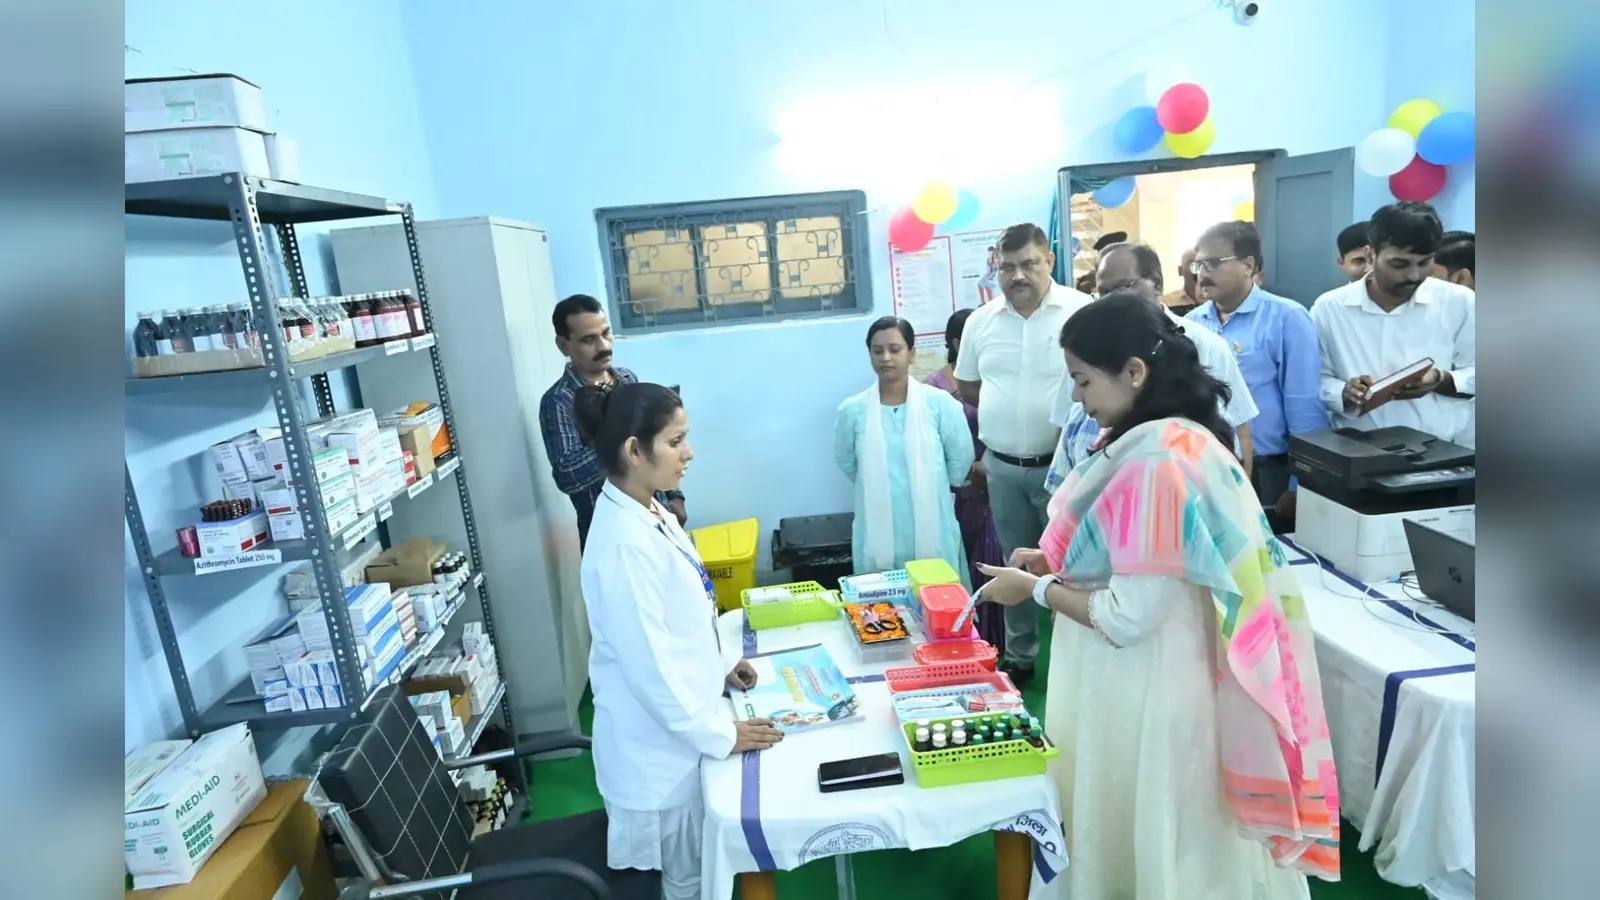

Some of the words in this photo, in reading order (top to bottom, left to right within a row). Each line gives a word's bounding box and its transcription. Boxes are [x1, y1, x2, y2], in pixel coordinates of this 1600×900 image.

[196, 556, 236, 569] Azithromycin
[236, 554, 254, 564] Tablet
[710, 566, 733, 579] AVABLE
[175, 775, 221, 820] MEDI-AID
[125, 818, 161, 830] EDI-AID
[182, 810, 215, 841] SURGICAL
[1015, 814, 1048, 837] जिला
[185, 824, 213, 850] RUBBER
[189, 834, 214, 859] GLOVES
